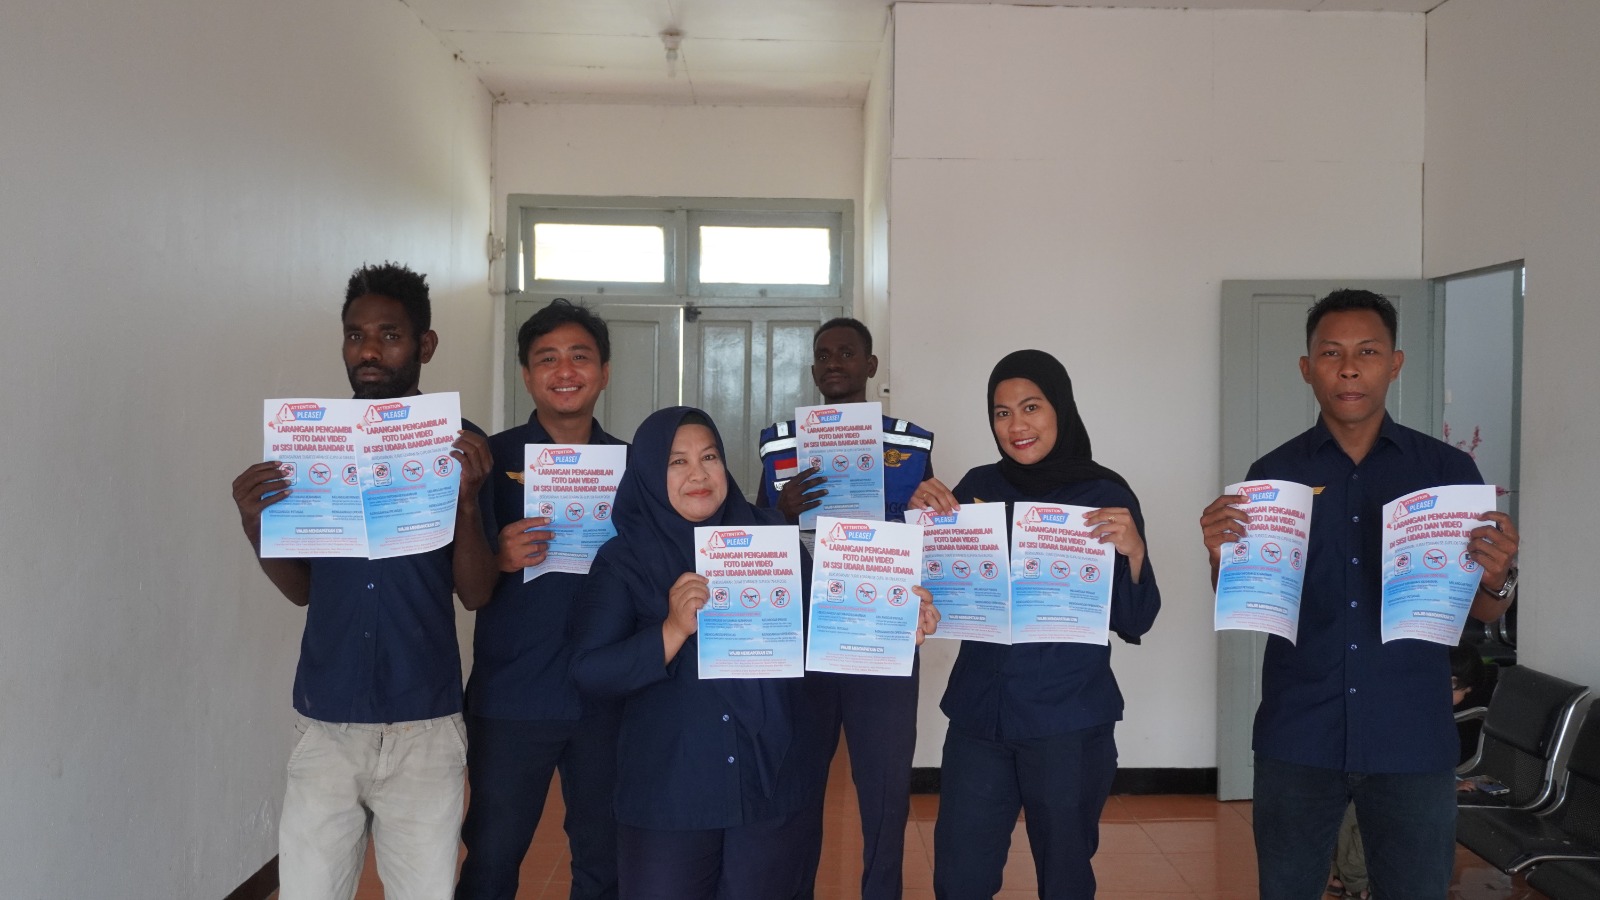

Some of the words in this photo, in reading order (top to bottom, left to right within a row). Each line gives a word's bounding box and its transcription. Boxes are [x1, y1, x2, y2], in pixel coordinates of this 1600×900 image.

[384, 410, 407, 419] PLEASE!
[366, 424, 401, 434] LARANGAN
[403, 418, 447, 431] PENGAMBILAN
[400, 432, 414, 440] DAN
[415, 430, 433, 438] VIDEO
[371, 444, 384, 452] SISI
[384, 442, 407, 451] UDARA
[408, 439, 432, 449] BANDAR
[434, 435, 454, 445] UDARA
[1410, 500, 1433, 511] PLEASE!
[1269, 506, 1305, 520] PENGAMBILAN
[1280, 516, 1295, 525] VIDEO
[1394, 514, 1426, 530] LARANGAN
[1025, 526, 1057, 534] LARANGAN
[1271, 524, 1294, 534] BANDAR
[1295, 530, 1306, 539] UDARA
[1406, 525, 1422, 534] FOTO
[1424, 522, 1439, 531] DAN
[1390, 540, 1395, 548] DI
[1396, 537, 1406, 545] SISI
[1408, 533, 1430, 542] UDARA
[830, 544, 864, 553] LARANGAN
[865, 546, 910, 557] PENGAMBILAN
[844, 563, 864, 572] UDARA
[893, 567, 914, 575] UDARA
